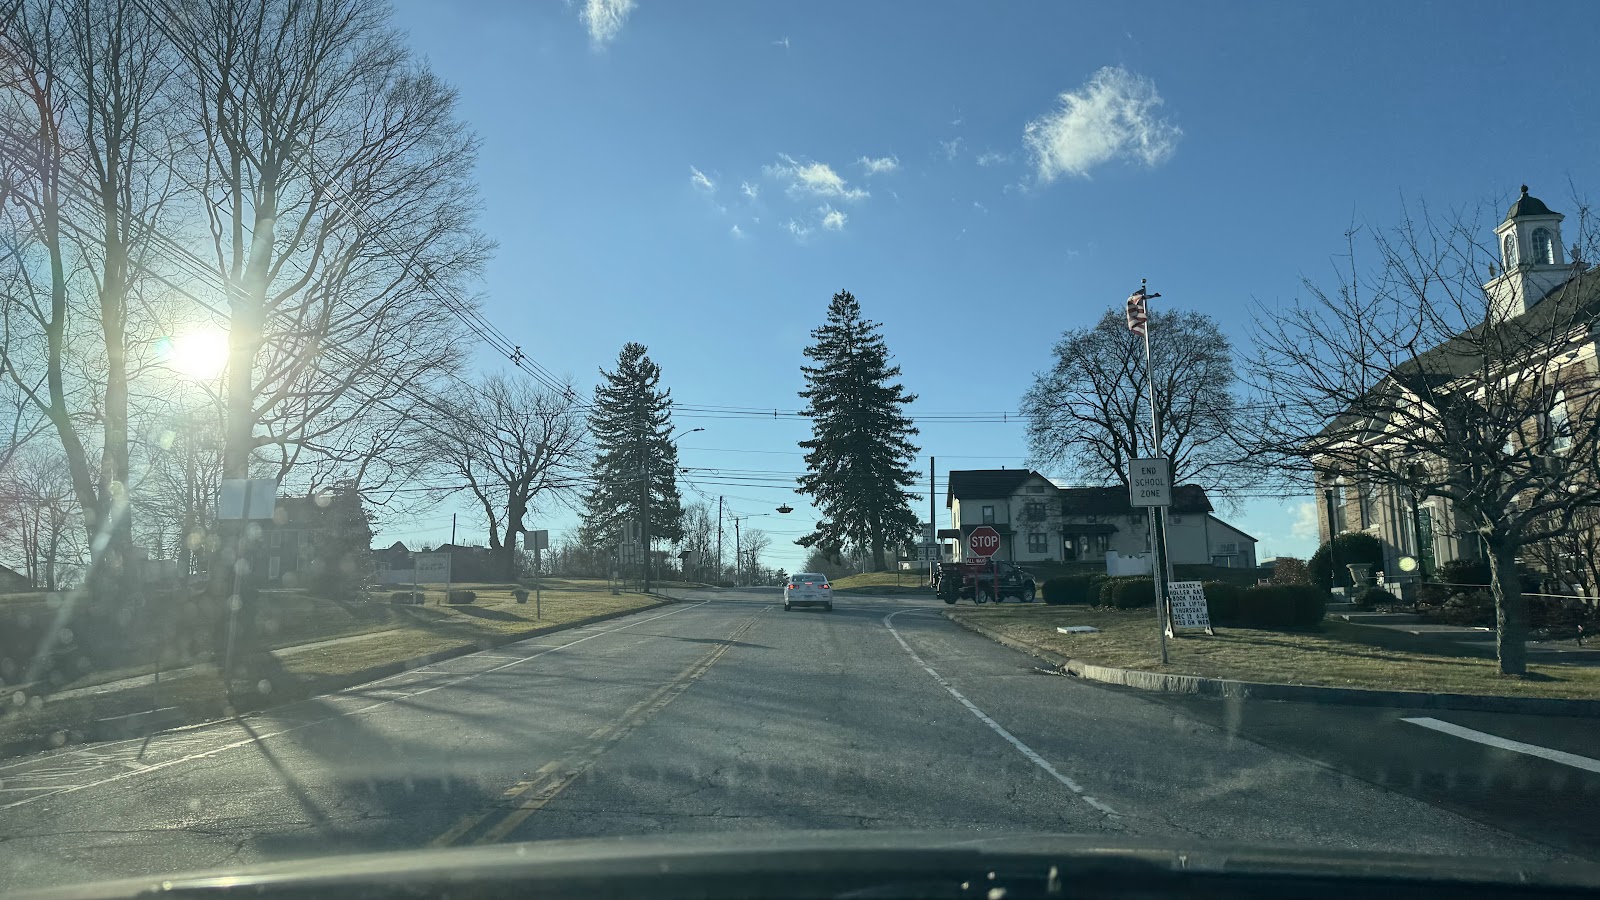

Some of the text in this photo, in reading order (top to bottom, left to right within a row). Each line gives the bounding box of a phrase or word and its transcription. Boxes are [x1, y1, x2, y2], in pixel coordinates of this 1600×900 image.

[1141, 467, 1157, 475] END
[1135, 478, 1165, 487] SCHOOL
[1140, 489, 1161, 498] ZONE
[971, 535, 998, 548] STOP
